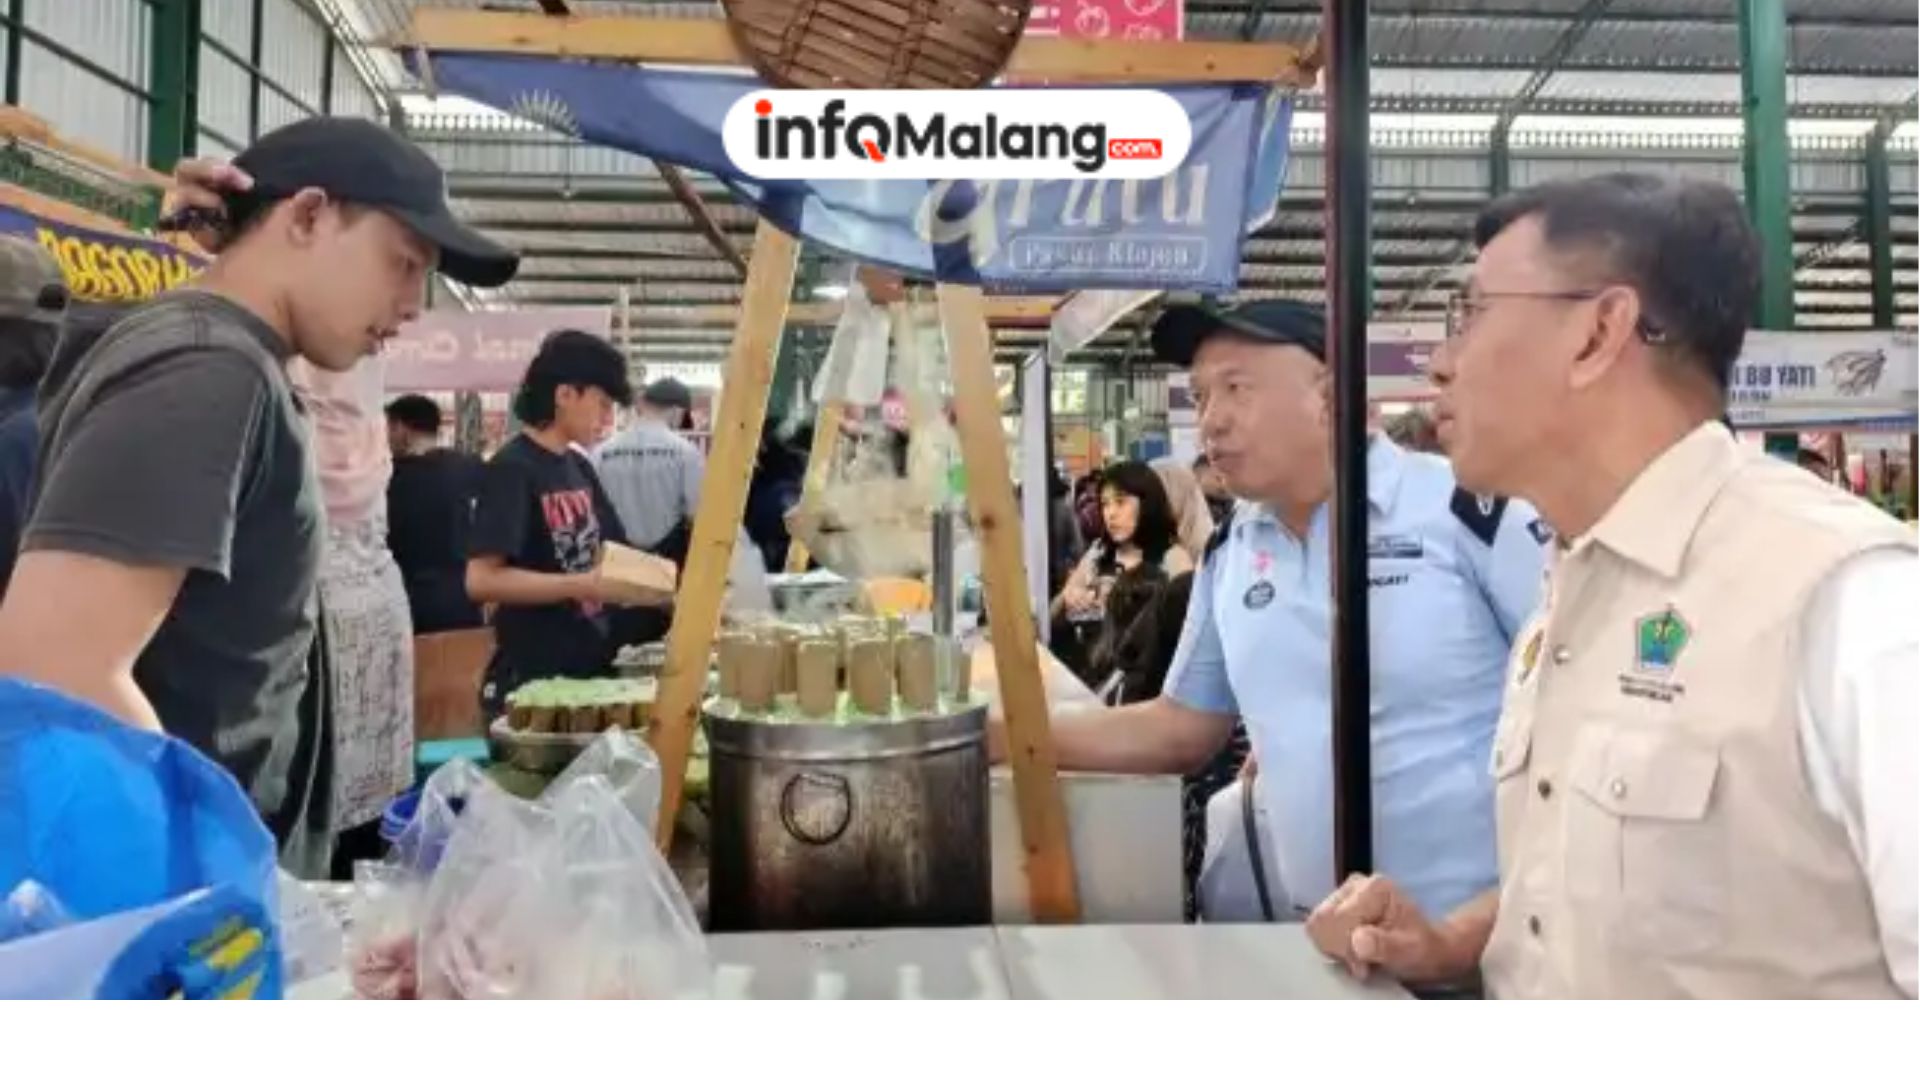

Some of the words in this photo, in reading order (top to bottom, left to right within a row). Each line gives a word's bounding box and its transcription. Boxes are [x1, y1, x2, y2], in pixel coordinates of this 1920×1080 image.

[1025, 242, 1097, 264] Pasar
[1107, 241, 1189, 268] Klojen
[1776, 365, 1817, 388] YATI
